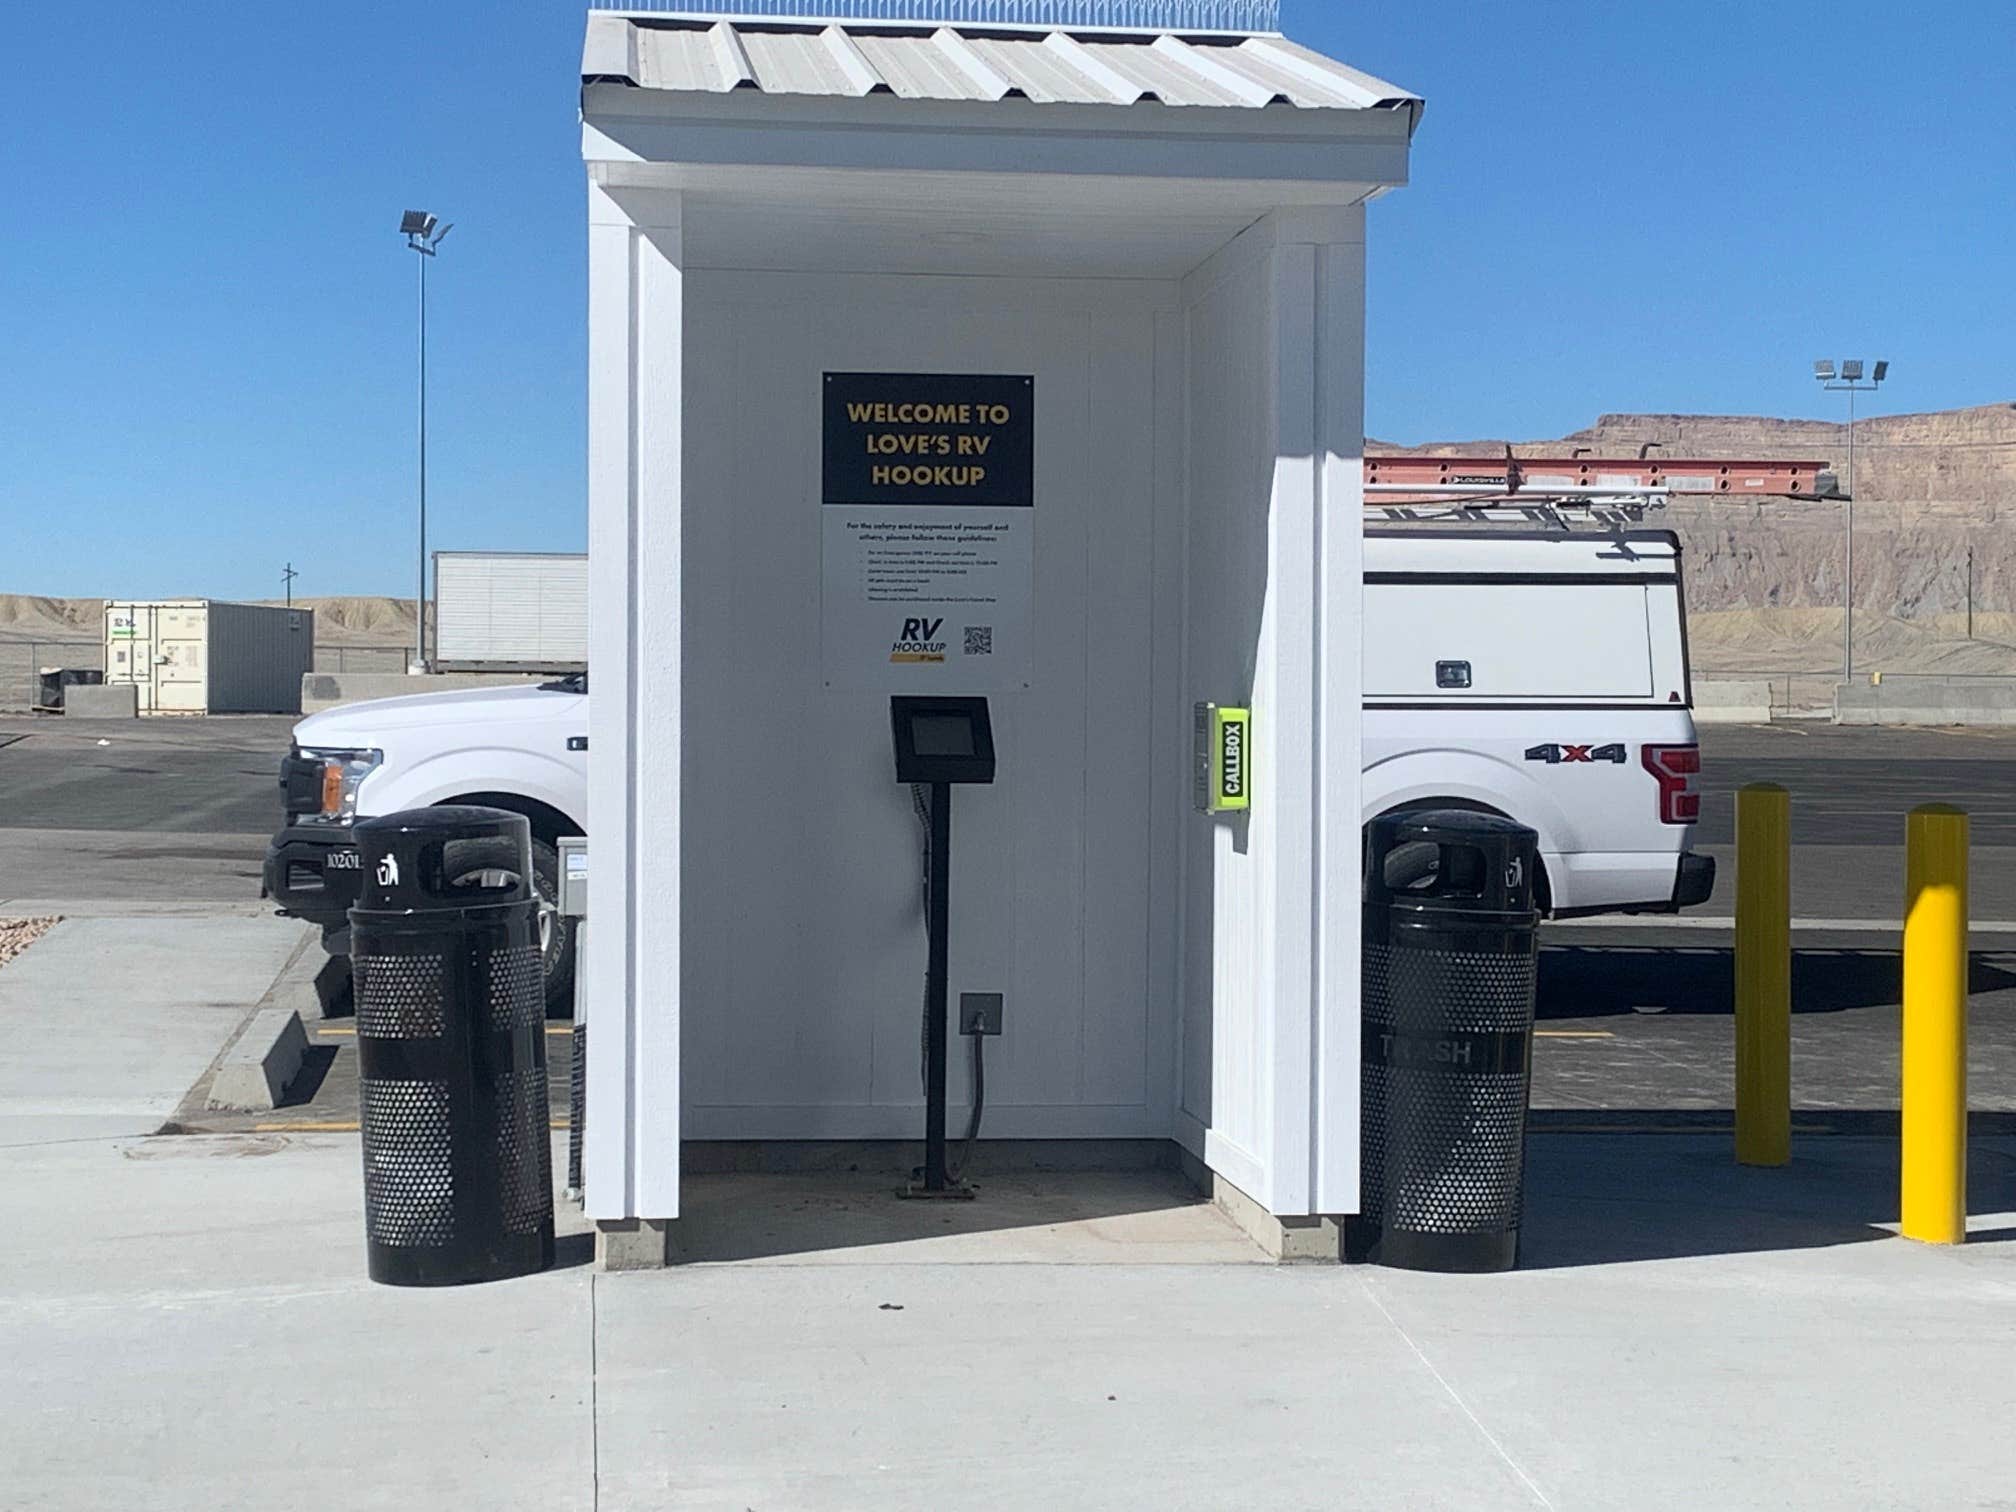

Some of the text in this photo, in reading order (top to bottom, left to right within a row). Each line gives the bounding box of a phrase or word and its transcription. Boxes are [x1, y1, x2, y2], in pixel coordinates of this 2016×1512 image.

[847, 403, 1010, 425] WELCOME TO
[867, 434, 992, 455] LOVE'S RV
[872, 465, 985, 486] HOOKUP
[873, 522, 896, 531] safety
[914, 523, 952, 532] enjoyment
[963, 523, 993, 532] yourself
[886, 533, 910, 542] please
[912, 533, 934, 541] follow
[936, 534, 956, 542] these
[901, 618, 944, 641] RV
[892, 642, 946, 653] HOOKUP
[1225, 724, 1240, 794] CALLBOX
